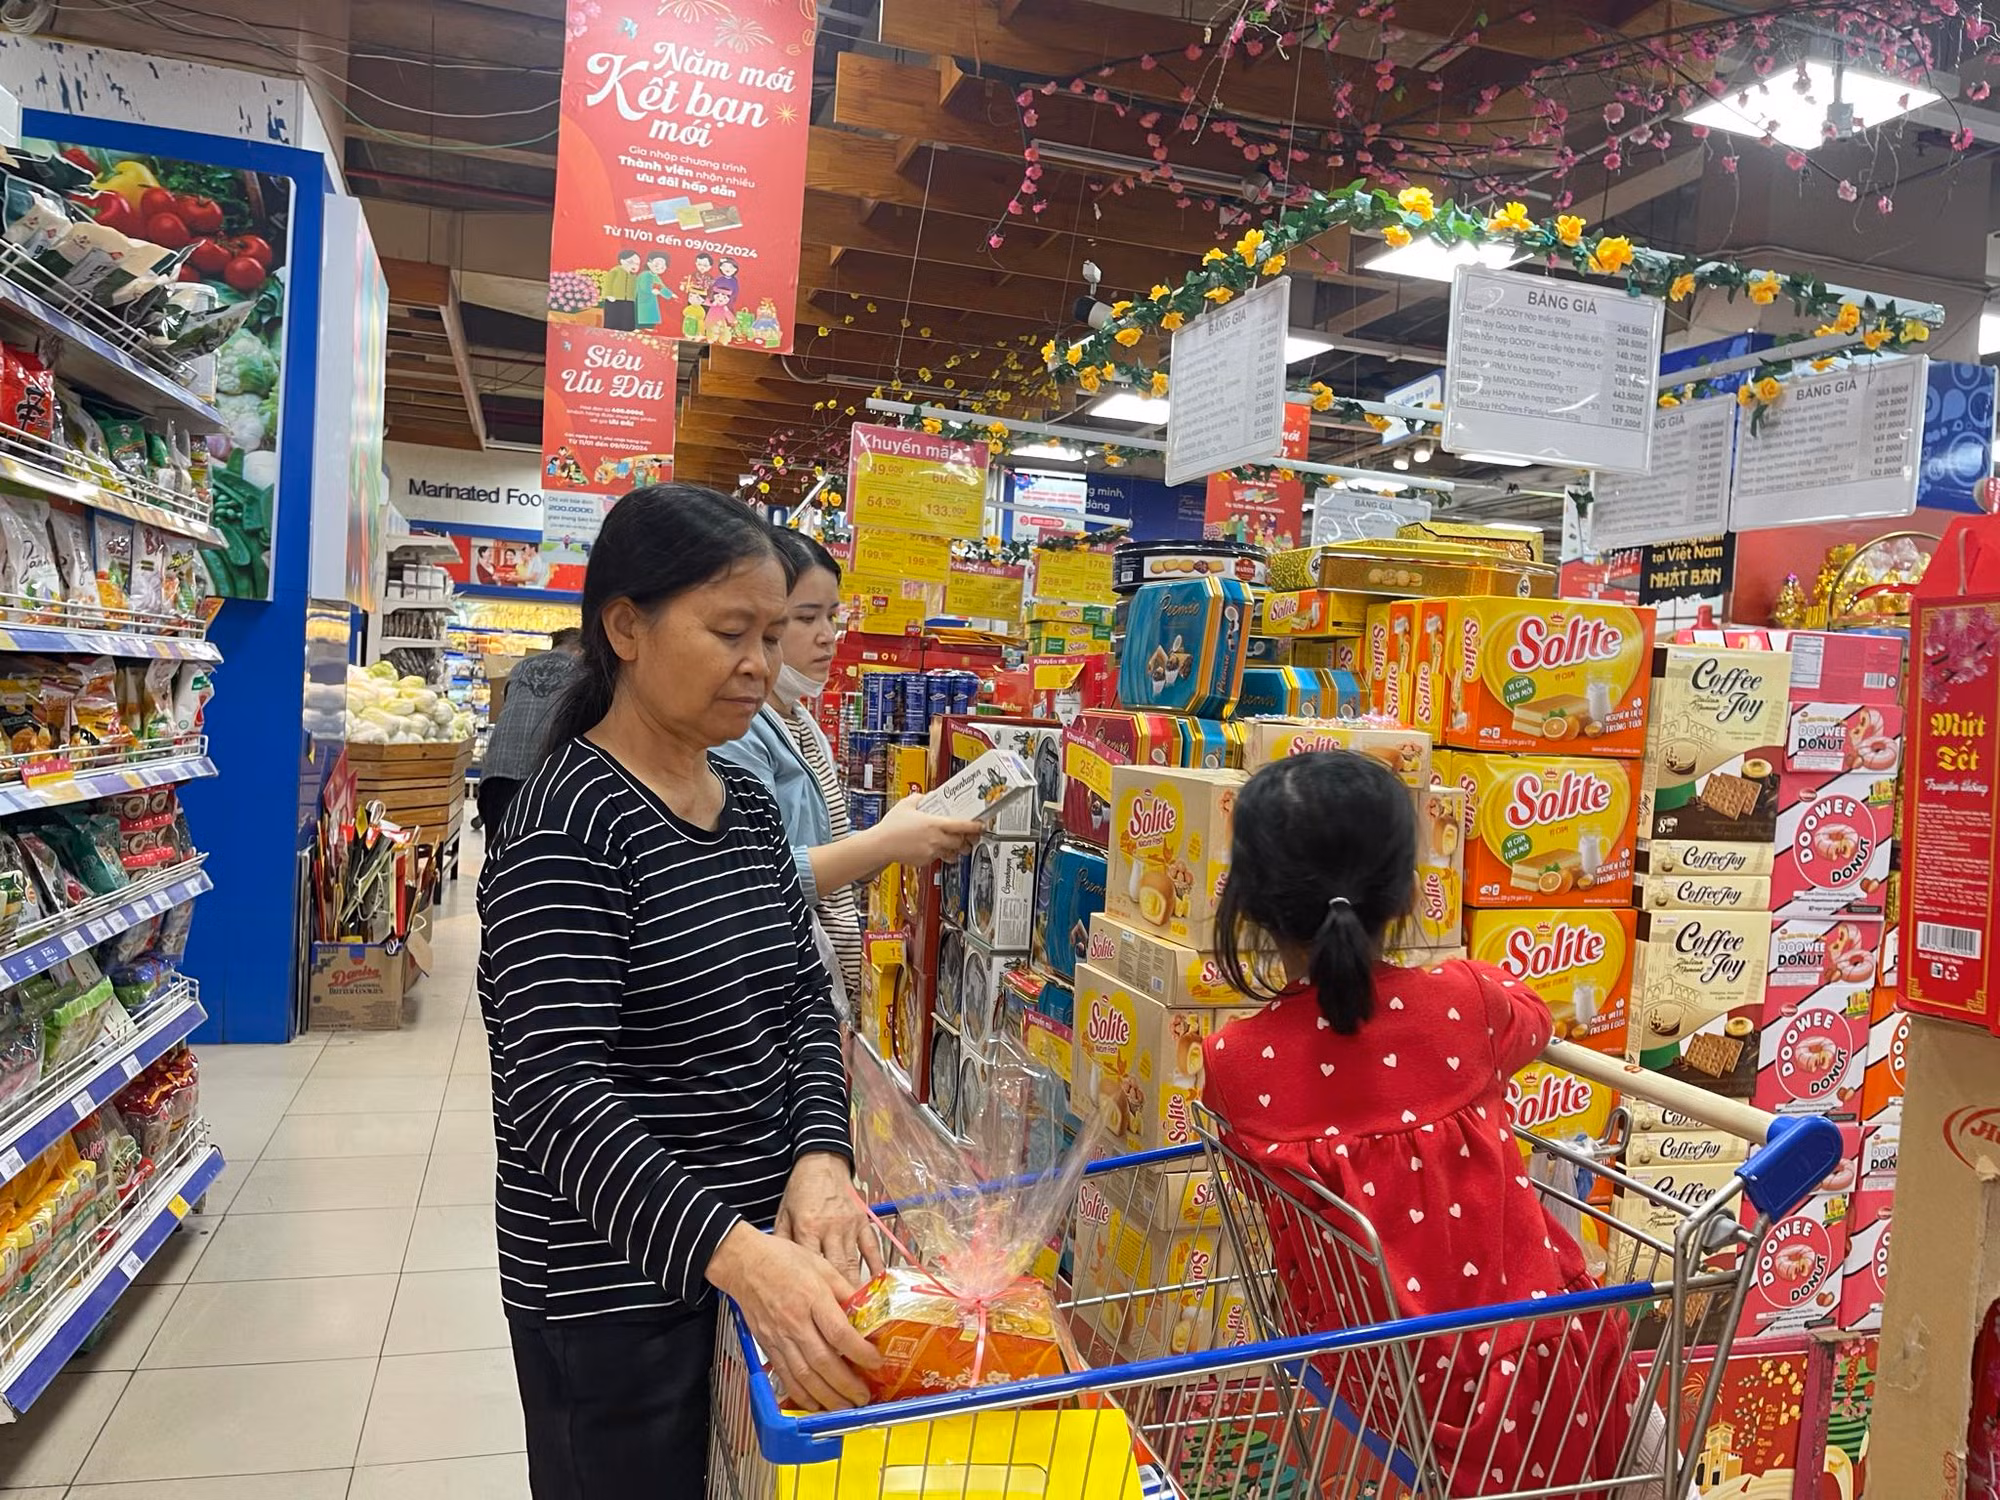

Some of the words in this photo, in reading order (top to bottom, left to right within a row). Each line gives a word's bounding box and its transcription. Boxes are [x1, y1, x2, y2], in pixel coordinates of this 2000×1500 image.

[653, 41, 733, 81] Năm
[738, 66, 796, 93] mới
[586, 52, 680, 121] Kết
[684, 80, 769, 129] bạn
[648, 119, 713, 148] mới
[617, 155, 662, 172] Thành
[664, 164, 694, 178] viên
[695, 170, 724, 183] nhận
[725, 175, 756, 188] nhiều
[628, 145, 648, 156] Gia
[649, 149, 678, 162] nhập
[721, 162, 748, 175] trình
[636, 173, 654, 183] ưu
[657, 175, 679, 188] đãi
[681, 181, 708, 194] hấp
[710, 183, 737, 198] dẫn
[603, 224, 622, 237] Từ
[623, 227, 653, 242] 11/01
[655, 234, 682, 247] đến
[684, 238, 759, 259] 09/02/2024
[1527, 289, 1569, 311] BẢNG
[1572, 298, 1598, 315] GIÁ
[1208, 316, 1231, 337] BẢNG
[1231, 307, 1247, 325] GIÁ
[584, 345, 645, 371] Siêu
[561, 369, 605, 394] Ưu
[609, 375, 665, 400] Đãi
[1796, 382, 1832, 401] BẢNG
[1835, 375, 1857, 393] GIÁ
[860, 434, 921, 455] Khuyến
[408, 478, 500, 504] Marinated
[506, 488, 544, 507] Foo
[1097, 486, 1125, 499] minh,
[1652, 552, 1666, 565] tại
[1666, 547, 1693, 562] Việt
[1693, 545, 1724, 558] Nam
[1649, 566, 1687, 591] NHẬT
[1689, 563, 1722, 586] BẢN
[1268, 596, 1299, 623] Solite
[1372, 622, 1386, 679] Solite
[1463, 617, 1481, 680] Solite
[1508, 614, 1622, 673] Solite
[1386, 664, 1400, 718] Solite
[1691, 657, 1763, 695] Coffee
[1417, 664, 1432, 723] Solite
[1716, 691, 1764, 723] Joy
[1798, 725, 1847, 737] DOOWEE
[1929, 711, 1987, 737] Mứt
[1798, 738, 1844, 750] DONUT
[1936, 739, 1980, 772] Tết
[943, 768, 982, 799] Copenhagen
[1505, 769, 1612, 830] Solite
[1129, 798, 1177, 838] Solite
[1798, 798, 1856, 864] DOOWEE
[1831, 837, 1871, 884] DONUT
[1426, 873, 1444, 921] Solite
[1089, 934, 1116, 960] Solite
[1500, 921, 1606, 981] Solite
[1675, 920, 1744, 958] Coffee
[1777, 941, 1826, 953] DOOWEE
[1700, 953, 1747, 984] Joy
[1777, 954, 1824, 966] DONUT
[1089, 1000, 1130, 1045] Solite
[1781, 1011, 1834, 1077] DOOWEE
[1810, 1048, 1847, 1094] DONUT
[1168, 1093, 1188, 1144] Solite
[1079, 1185, 1110, 1225] Solite
[1760, 1220, 1813, 1287] DOOWEE
[1790, 1255, 1826, 1302] DONUT
